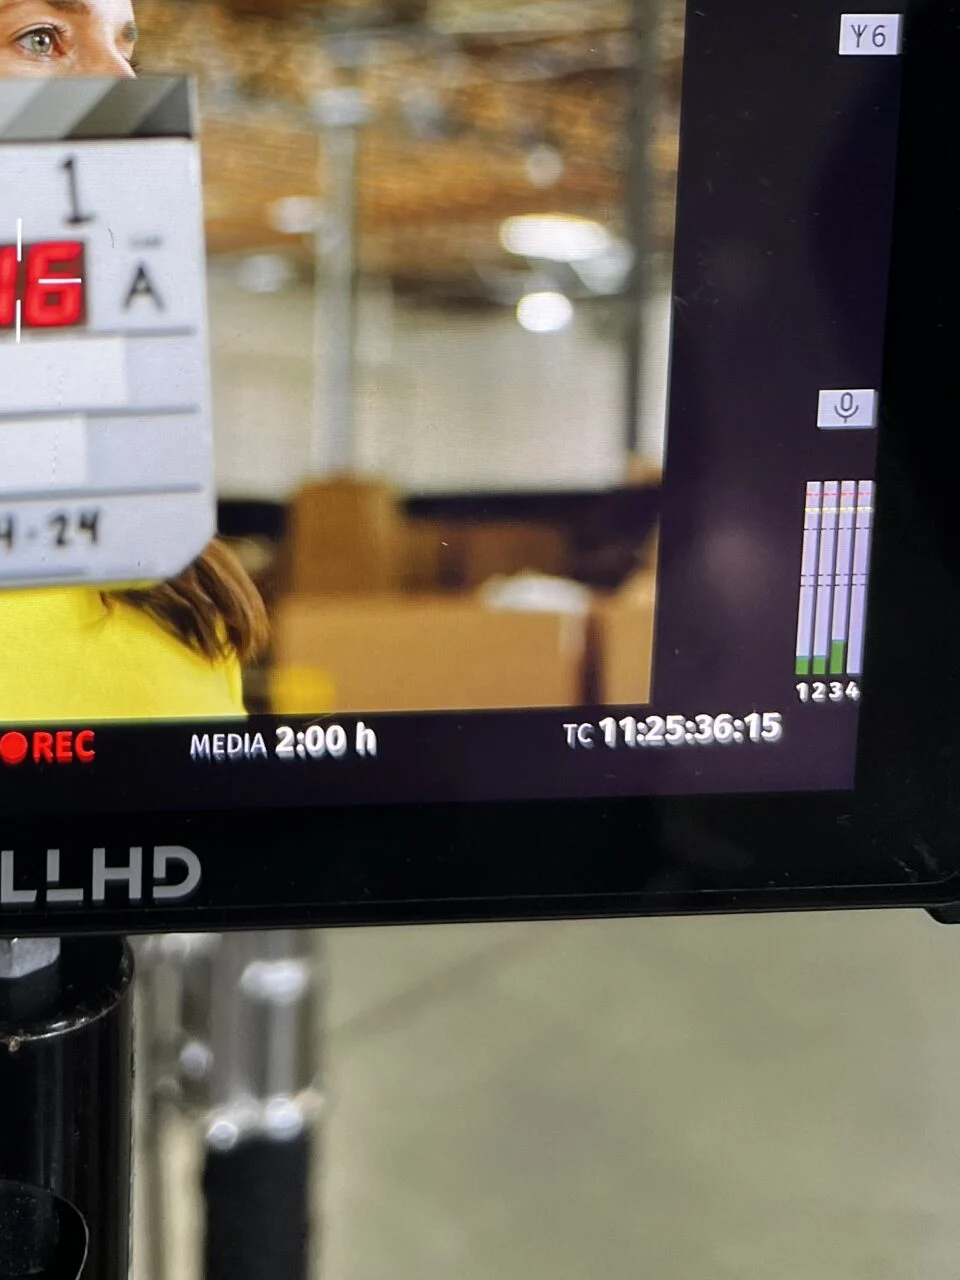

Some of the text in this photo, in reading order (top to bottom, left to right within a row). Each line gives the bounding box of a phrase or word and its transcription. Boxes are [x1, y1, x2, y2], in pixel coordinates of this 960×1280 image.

[61, 154, 95, 224] 1
[122, 260, 165, 312] A
[33, 730, 96, 763] REC
[190, 722, 377, 758] MEDIA 2:00 h
[563, 712, 783, 747] TC 11:25:36:15
